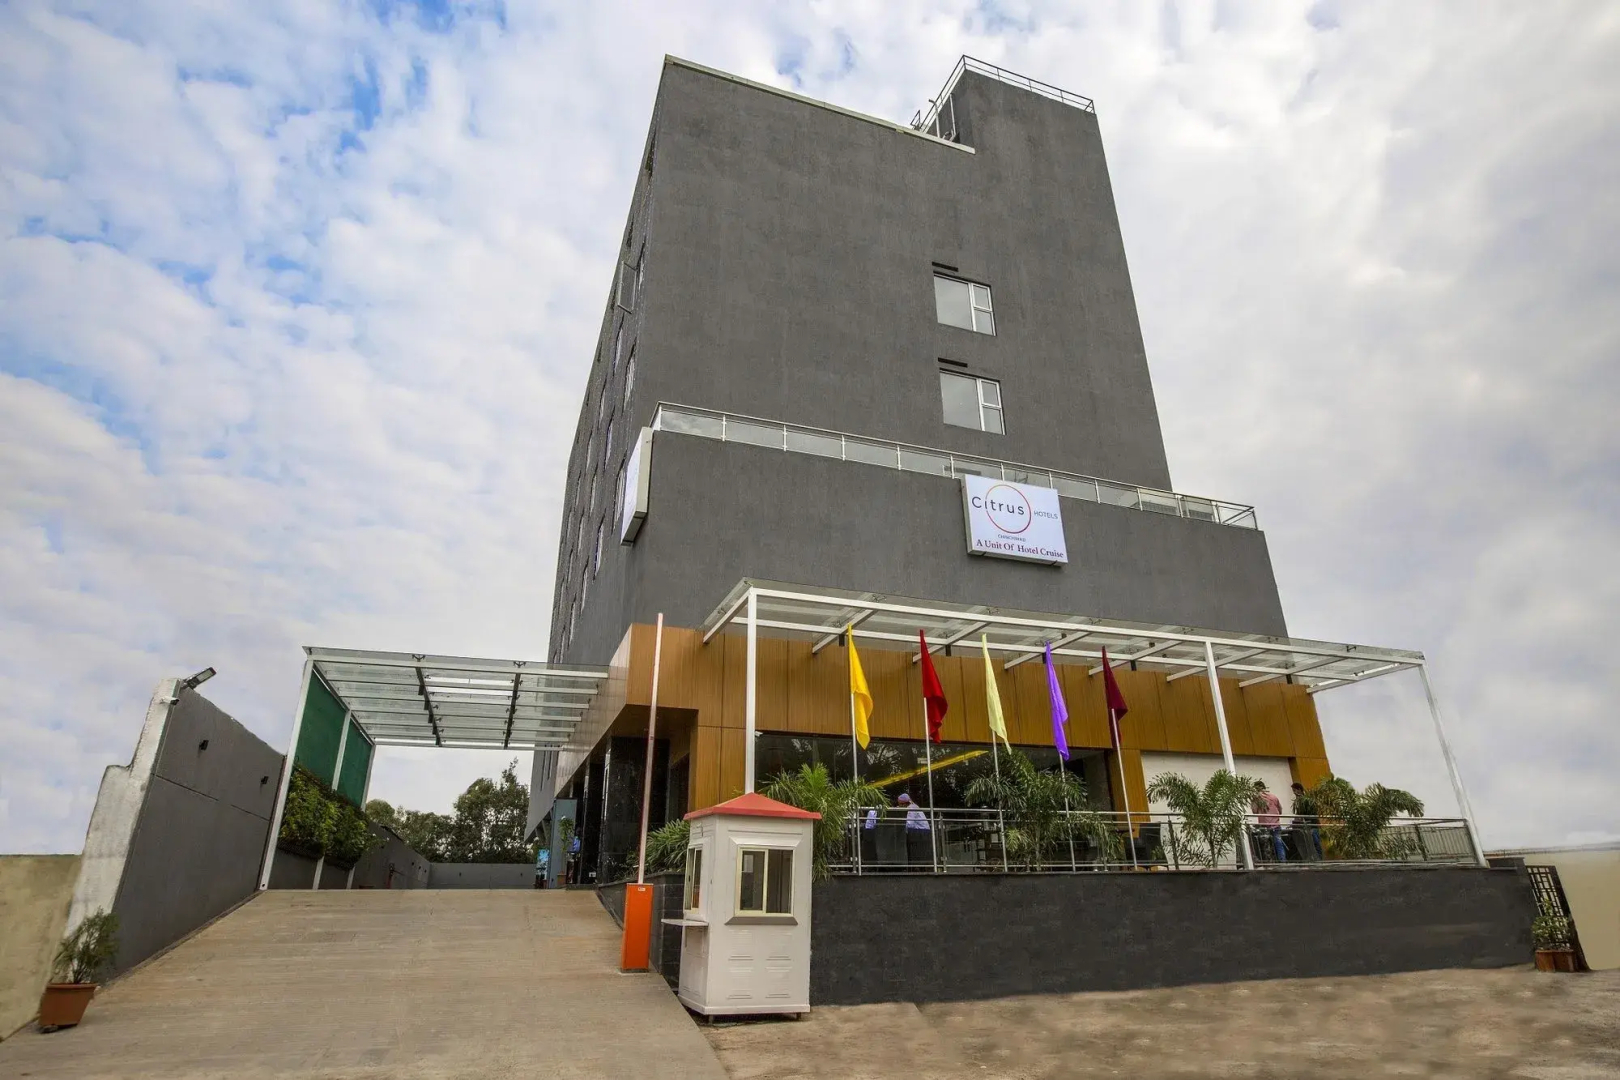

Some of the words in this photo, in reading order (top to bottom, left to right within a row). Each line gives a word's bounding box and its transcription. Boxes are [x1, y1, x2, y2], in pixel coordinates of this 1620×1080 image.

[971, 496, 1025, 516] Citrus
[1033, 510, 1059, 520] HOTELS
[976, 539, 983, 547] A
[984, 539, 1002, 550] Unit
[1003, 542, 1015, 551] Of
[1017, 544, 1039, 555] Hotel
[1040, 548, 1064, 558] Cruise
